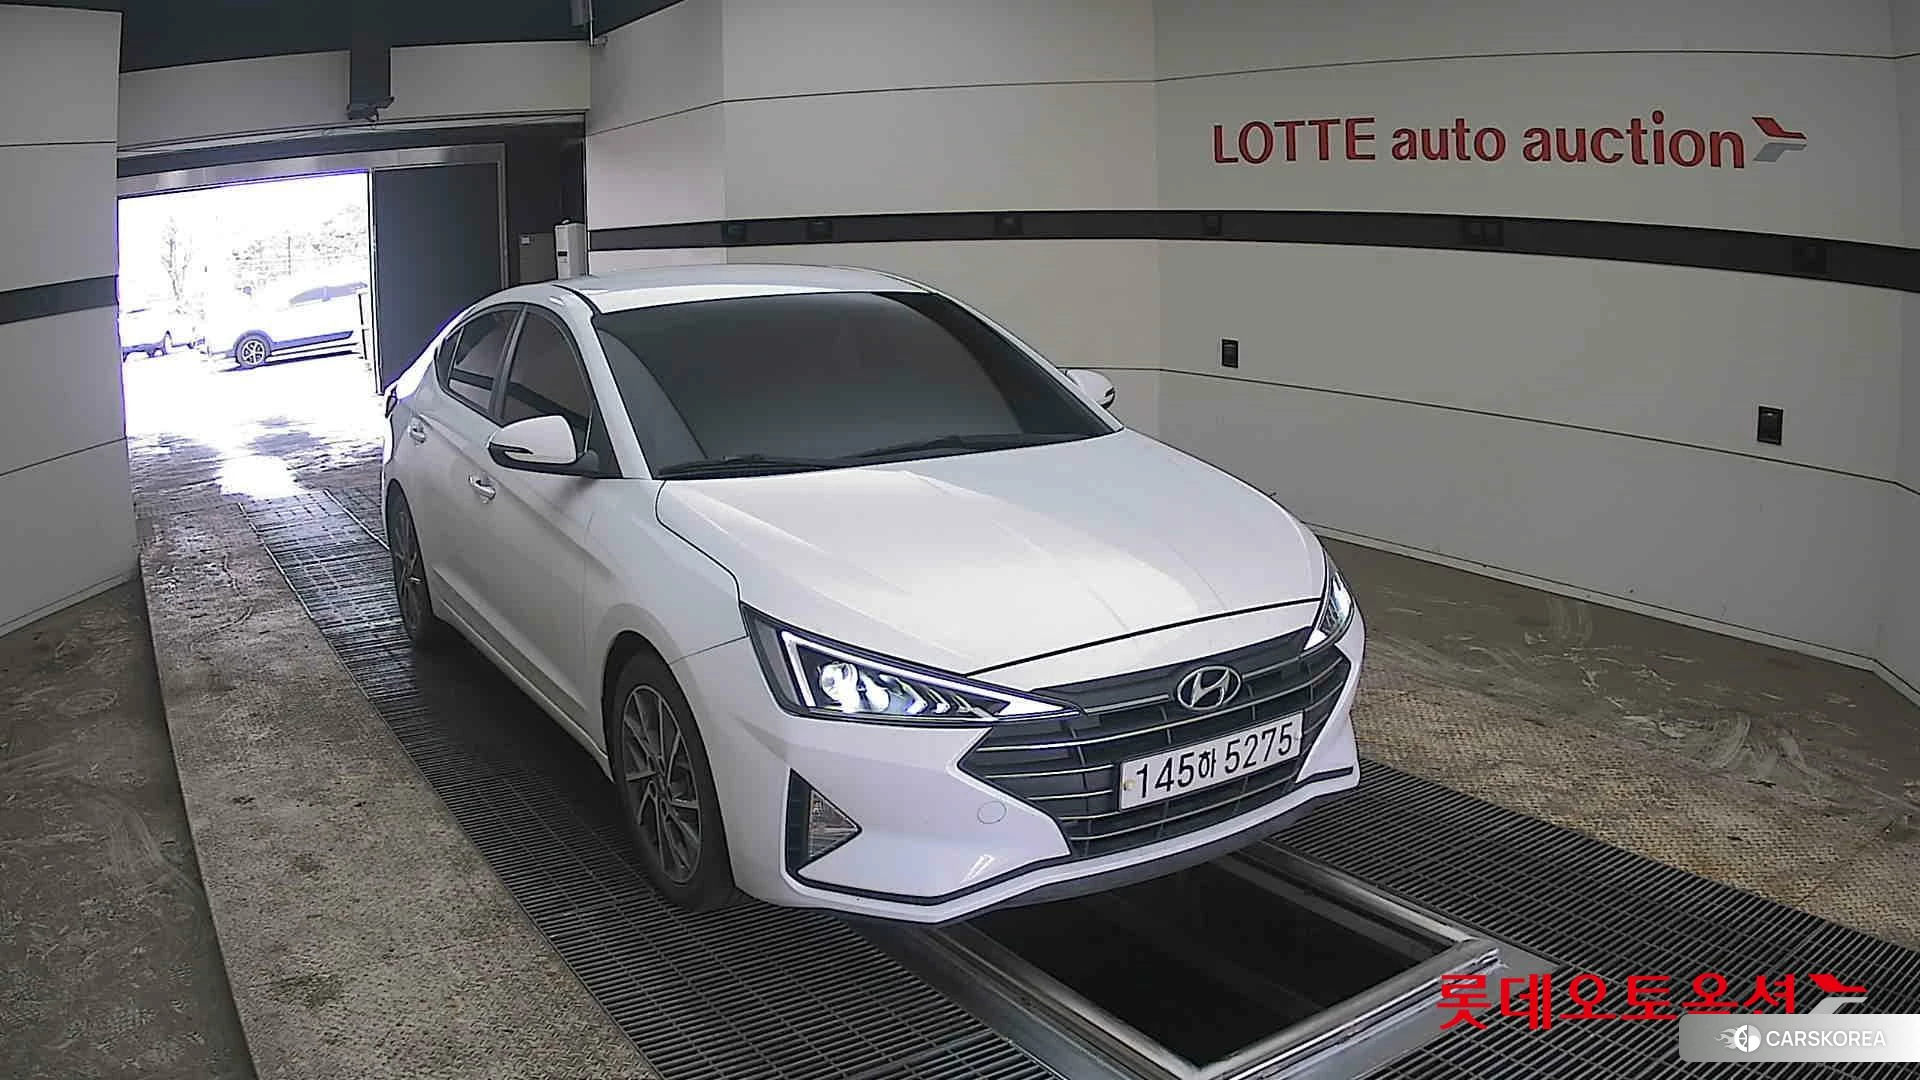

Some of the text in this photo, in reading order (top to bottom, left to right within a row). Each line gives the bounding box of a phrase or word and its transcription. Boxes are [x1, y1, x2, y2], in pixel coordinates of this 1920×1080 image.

[1213, 109, 1745, 169] LOTTE auto auction
[1137, 722, 1293, 798] 145하 5275
